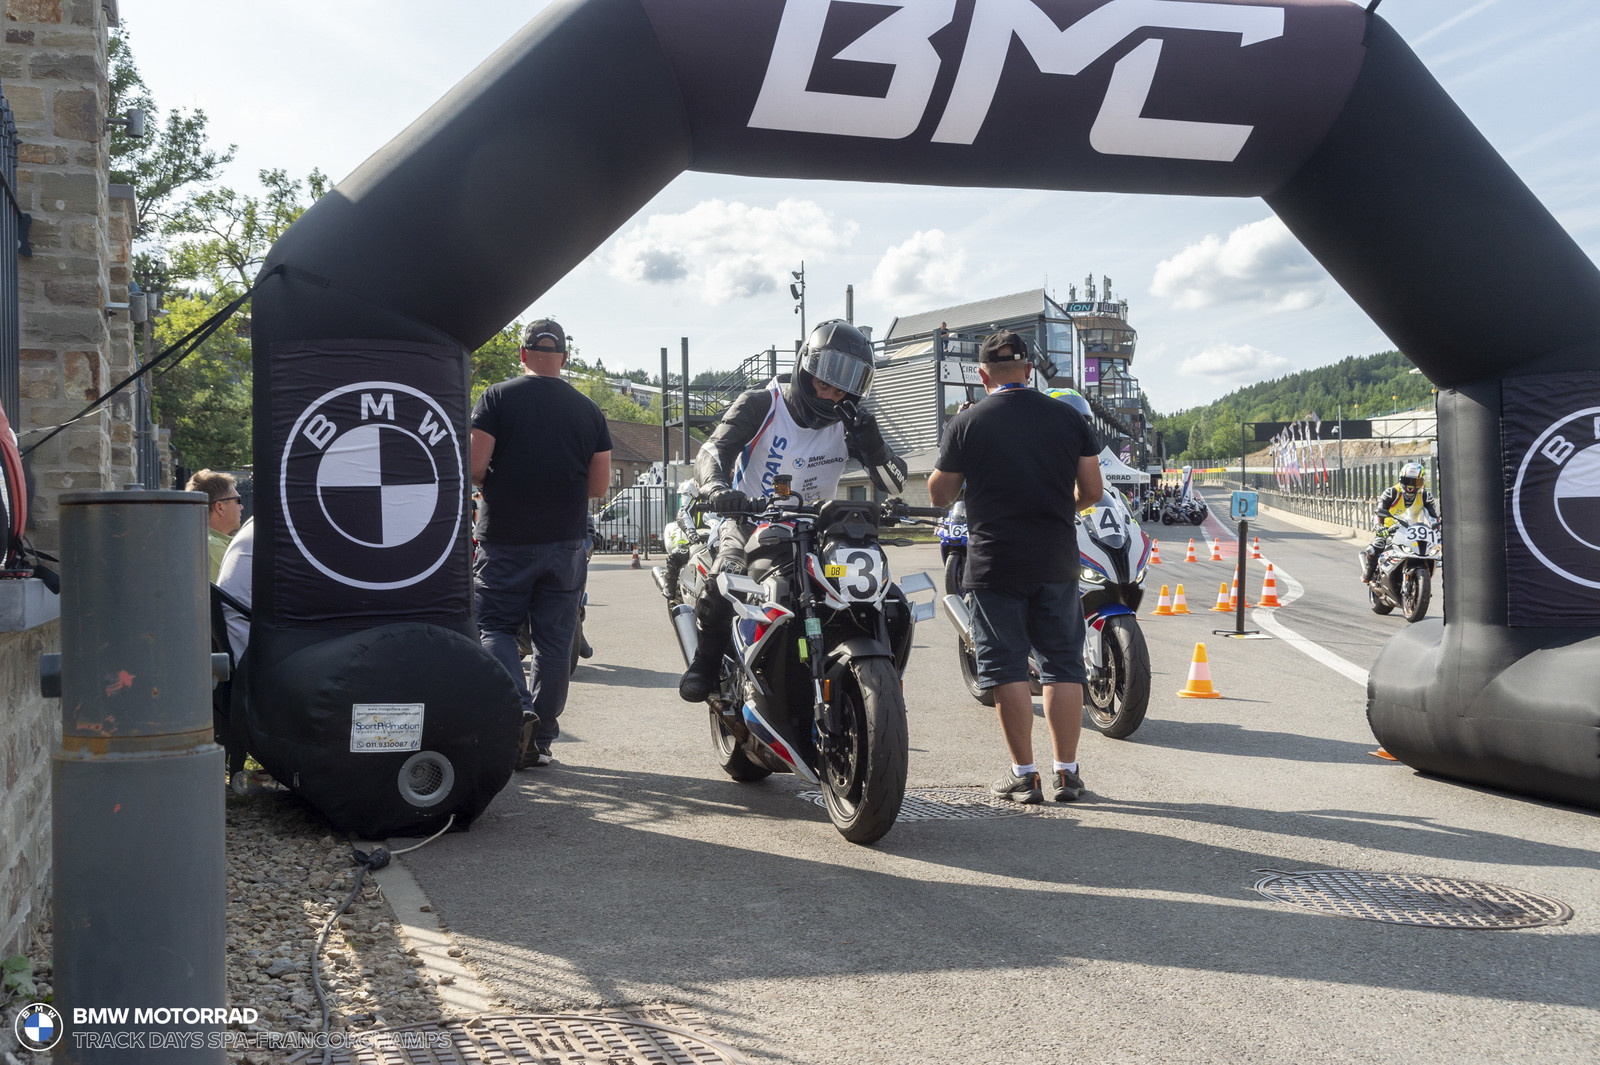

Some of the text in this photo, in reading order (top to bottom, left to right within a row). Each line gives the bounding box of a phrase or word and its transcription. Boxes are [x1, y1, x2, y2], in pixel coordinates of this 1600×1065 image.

[746, 0, 1285, 162] BMC
[302, 393, 448, 450] BMW
[807, 457, 844, 469] MOTORRAD
[808, 455, 826, 463] BMW
[1238, 498, 1249, 514] D
[1099, 507, 1121, 534] 4
[1406, 526, 1435, 543] 391
[845, 551, 875, 600] 3
